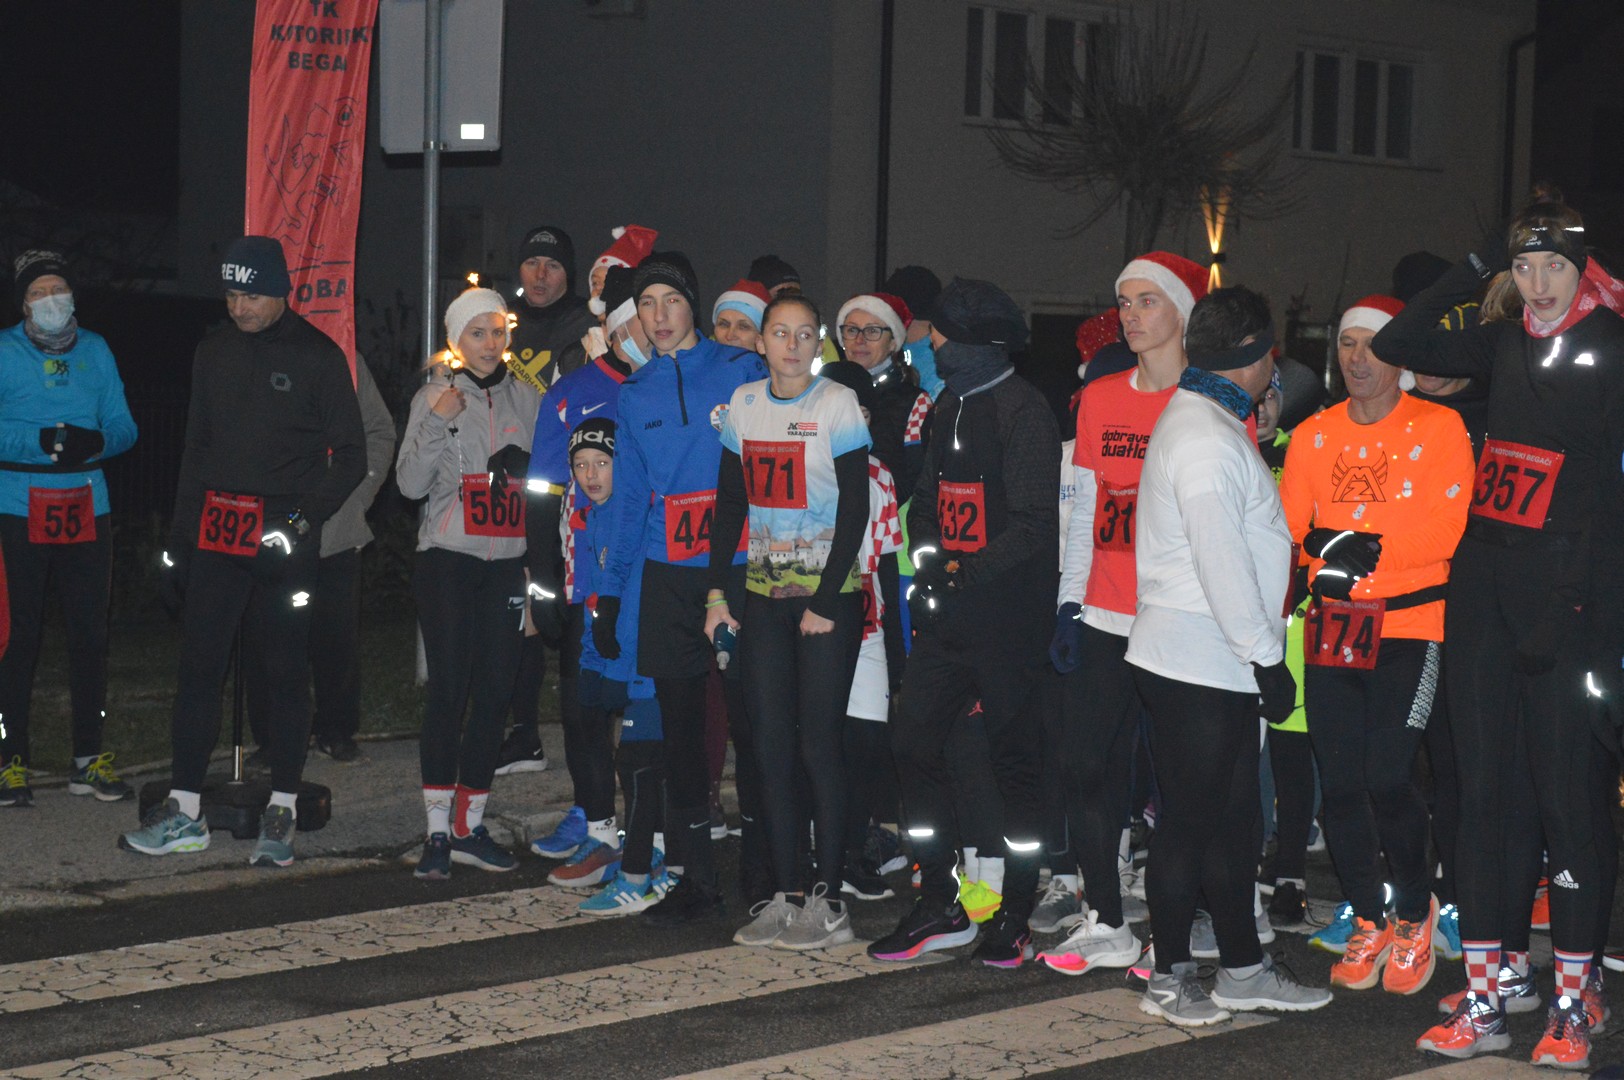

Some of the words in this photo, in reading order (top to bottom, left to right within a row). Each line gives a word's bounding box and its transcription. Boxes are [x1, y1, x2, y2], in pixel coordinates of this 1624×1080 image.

[310, 0, 338, 18] TK
[745, 456, 795, 500] 171
[1475, 460, 1548, 515] 357
[45, 504, 81, 538] 55
[206, 506, 257, 548] 392
[470, 490, 521, 527] 560
[1099, 500, 1133, 544] 31
[1310, 611, 1373, 658] 174
